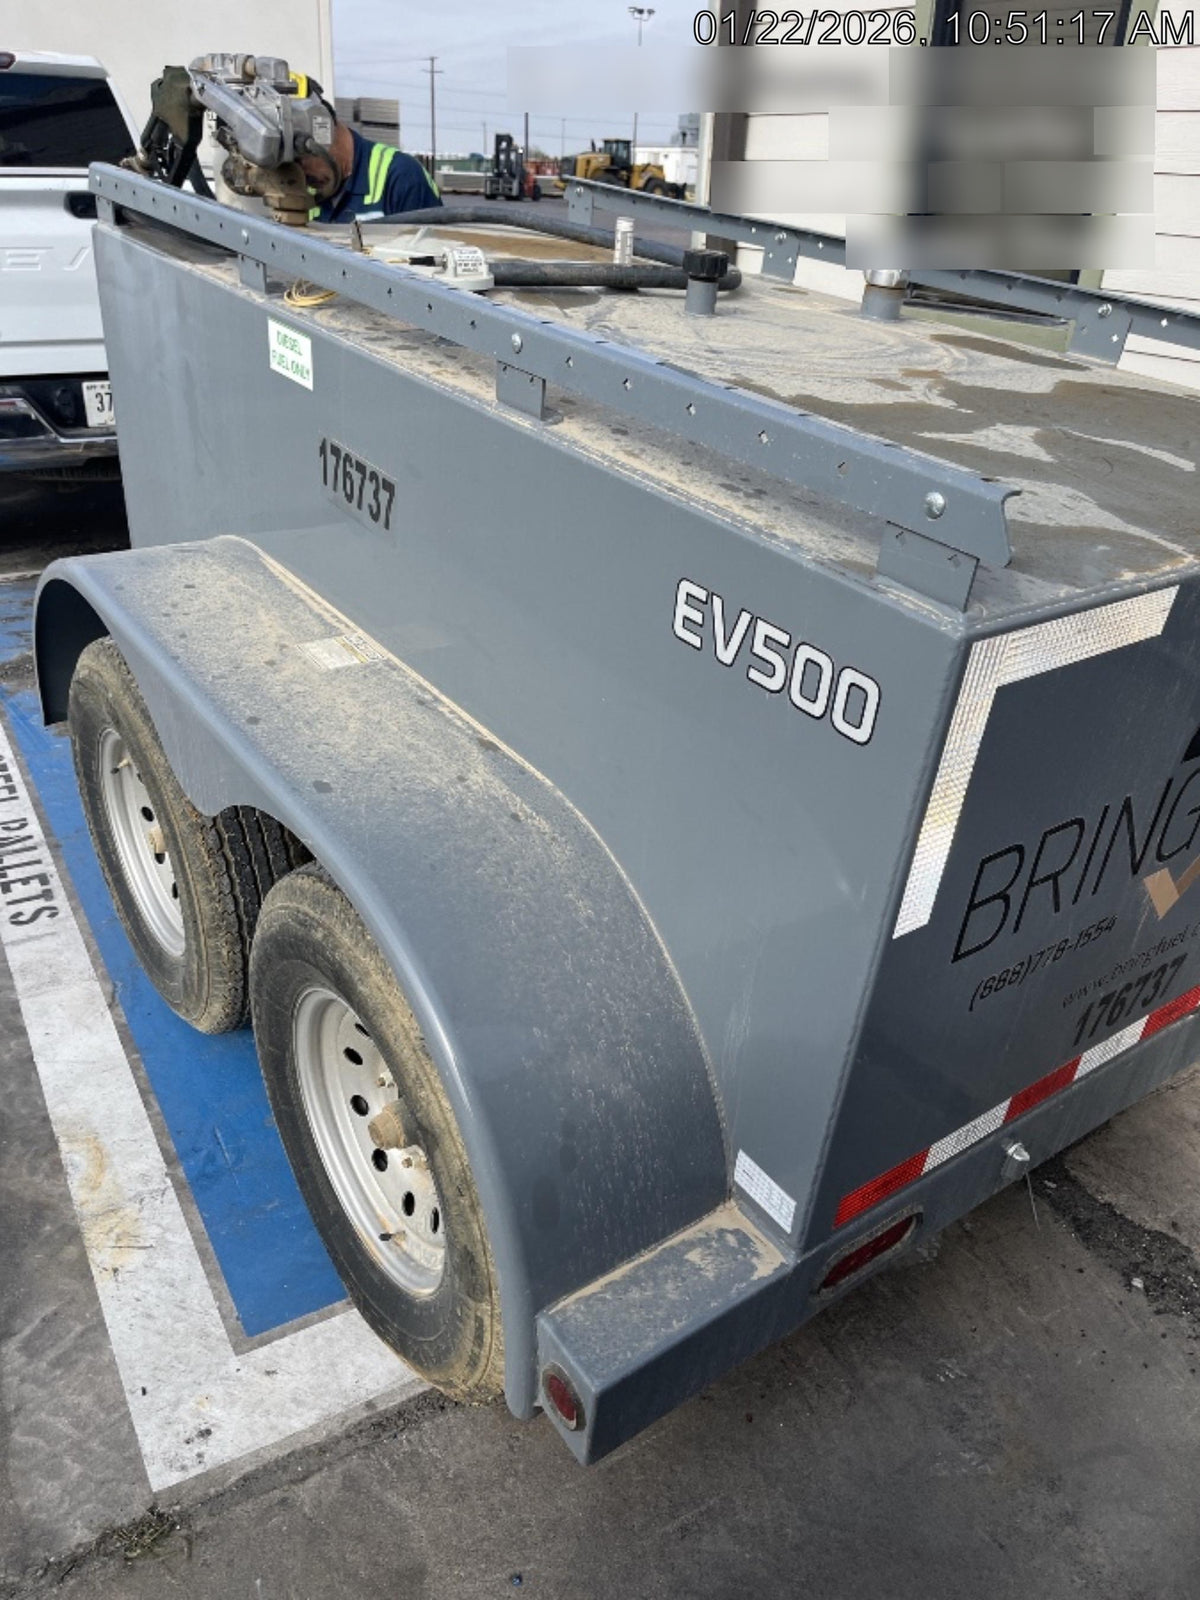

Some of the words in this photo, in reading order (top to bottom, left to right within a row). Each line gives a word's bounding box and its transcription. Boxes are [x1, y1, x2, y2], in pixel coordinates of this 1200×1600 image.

[276, 330, 303, 356] DIESEL
[290, 359, 311, 381] ONLY
[319, 436, 396, 531] 176737
[672, 576, 882, 747] EV500
[950, 767, 1200, 965] BRING
[967, 914, 1118, 1013] (888)778-1554
[1073, 951, 1188, 1047] 176737
